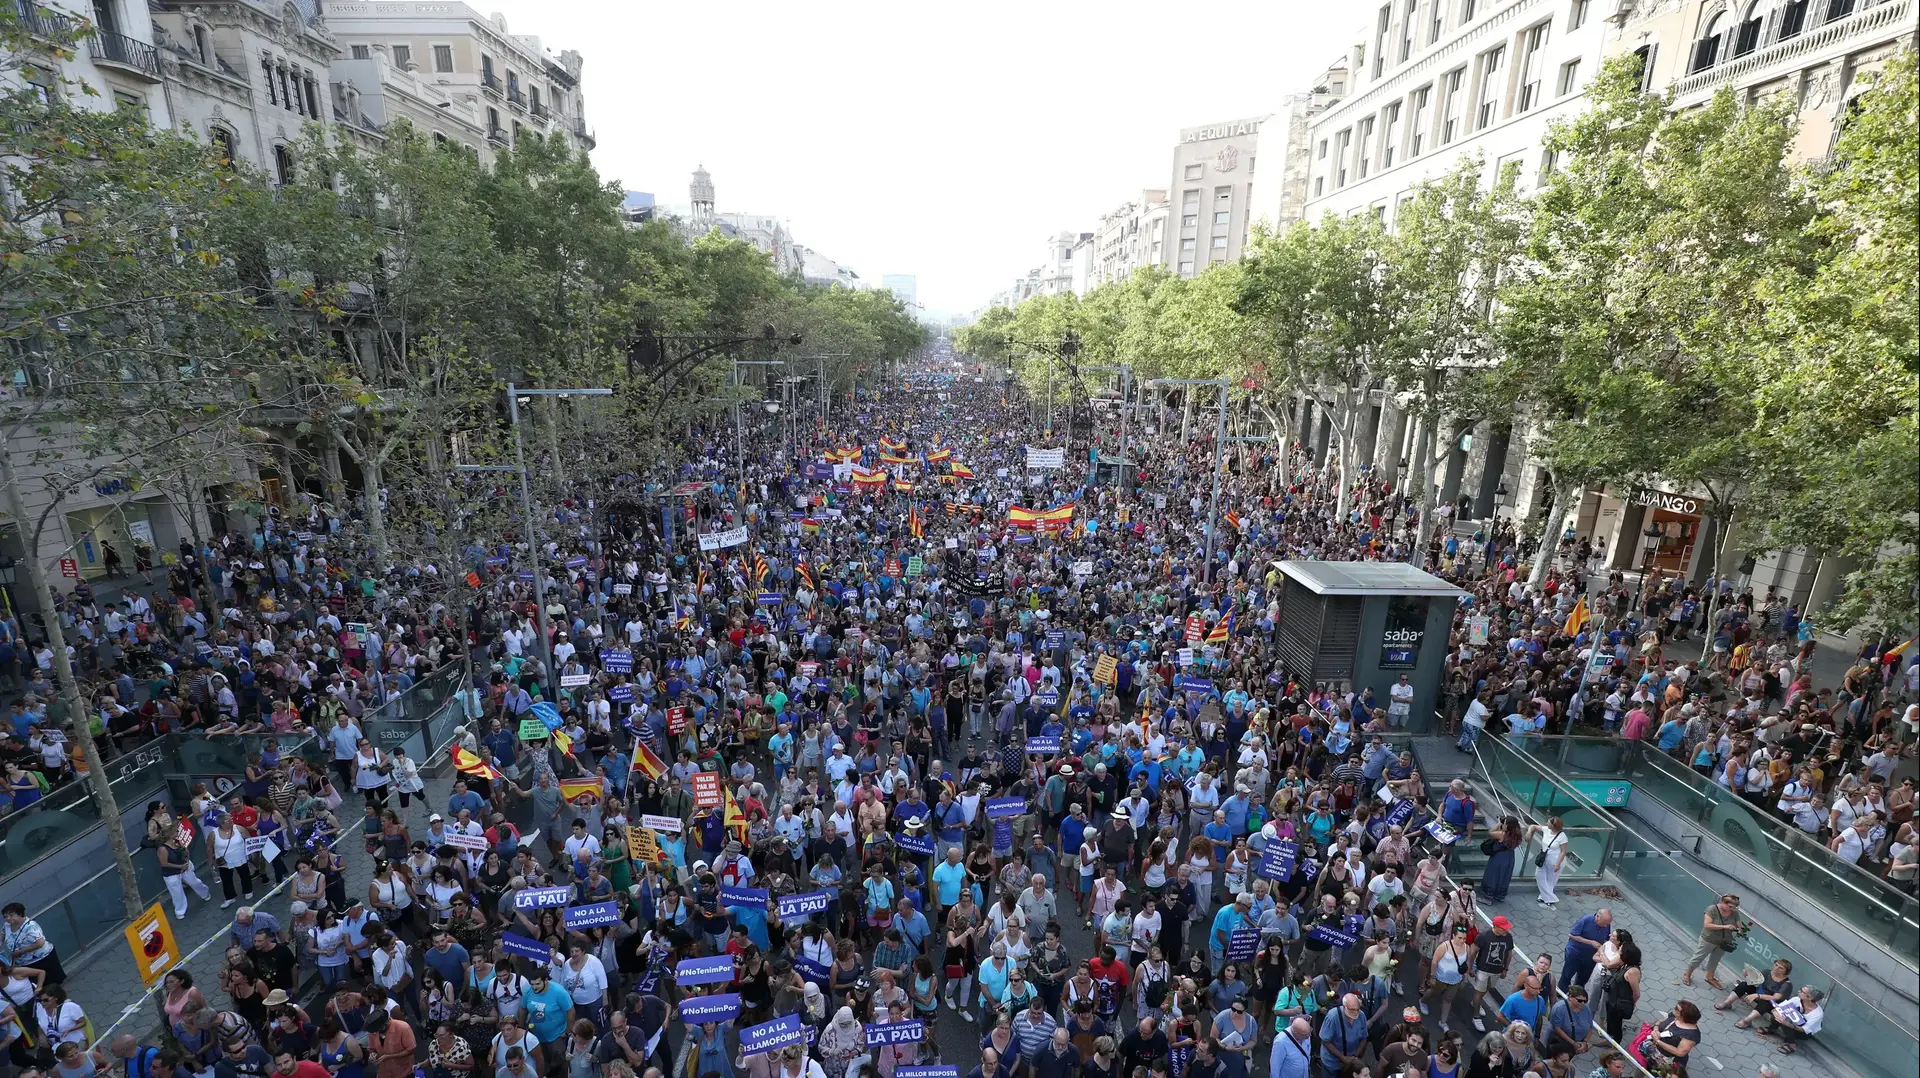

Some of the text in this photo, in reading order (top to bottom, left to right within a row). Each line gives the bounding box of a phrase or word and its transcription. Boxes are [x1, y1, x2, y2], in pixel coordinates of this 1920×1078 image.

[1199, 121, 1259, 141] EQUITATI
[1640, 490, 1697, 513] MANGO
[380, 729, 406, 739] saba
[1265, 847, 1295, 859] QUEREMOS
[1265, 863, 1287, 873] VENDER
[1265, 868, 1284, 877] ARMAS
[516, 893, 567, 908] LA PAU
[722, 893, 765, 903] #NoTenimPor
[780, 899, 826, 916] LA PAU
[566, 914, 618, 928] ISLAMOFÒBIA
[504, 940, 549, 955] #NoTenimPor
[679, 965, 732, 977] #NoTenimPor
[682, 1004, 737, 1015] #NoTenimPor
[752, 1022, 787, 1039] NO A LA
[895, 1022, 922, 1030] RESPOSTA
[743, 1030, 801, 1052] ISLAMOFÒBIA
[867, 1028, 922, 1044] LA PAU
